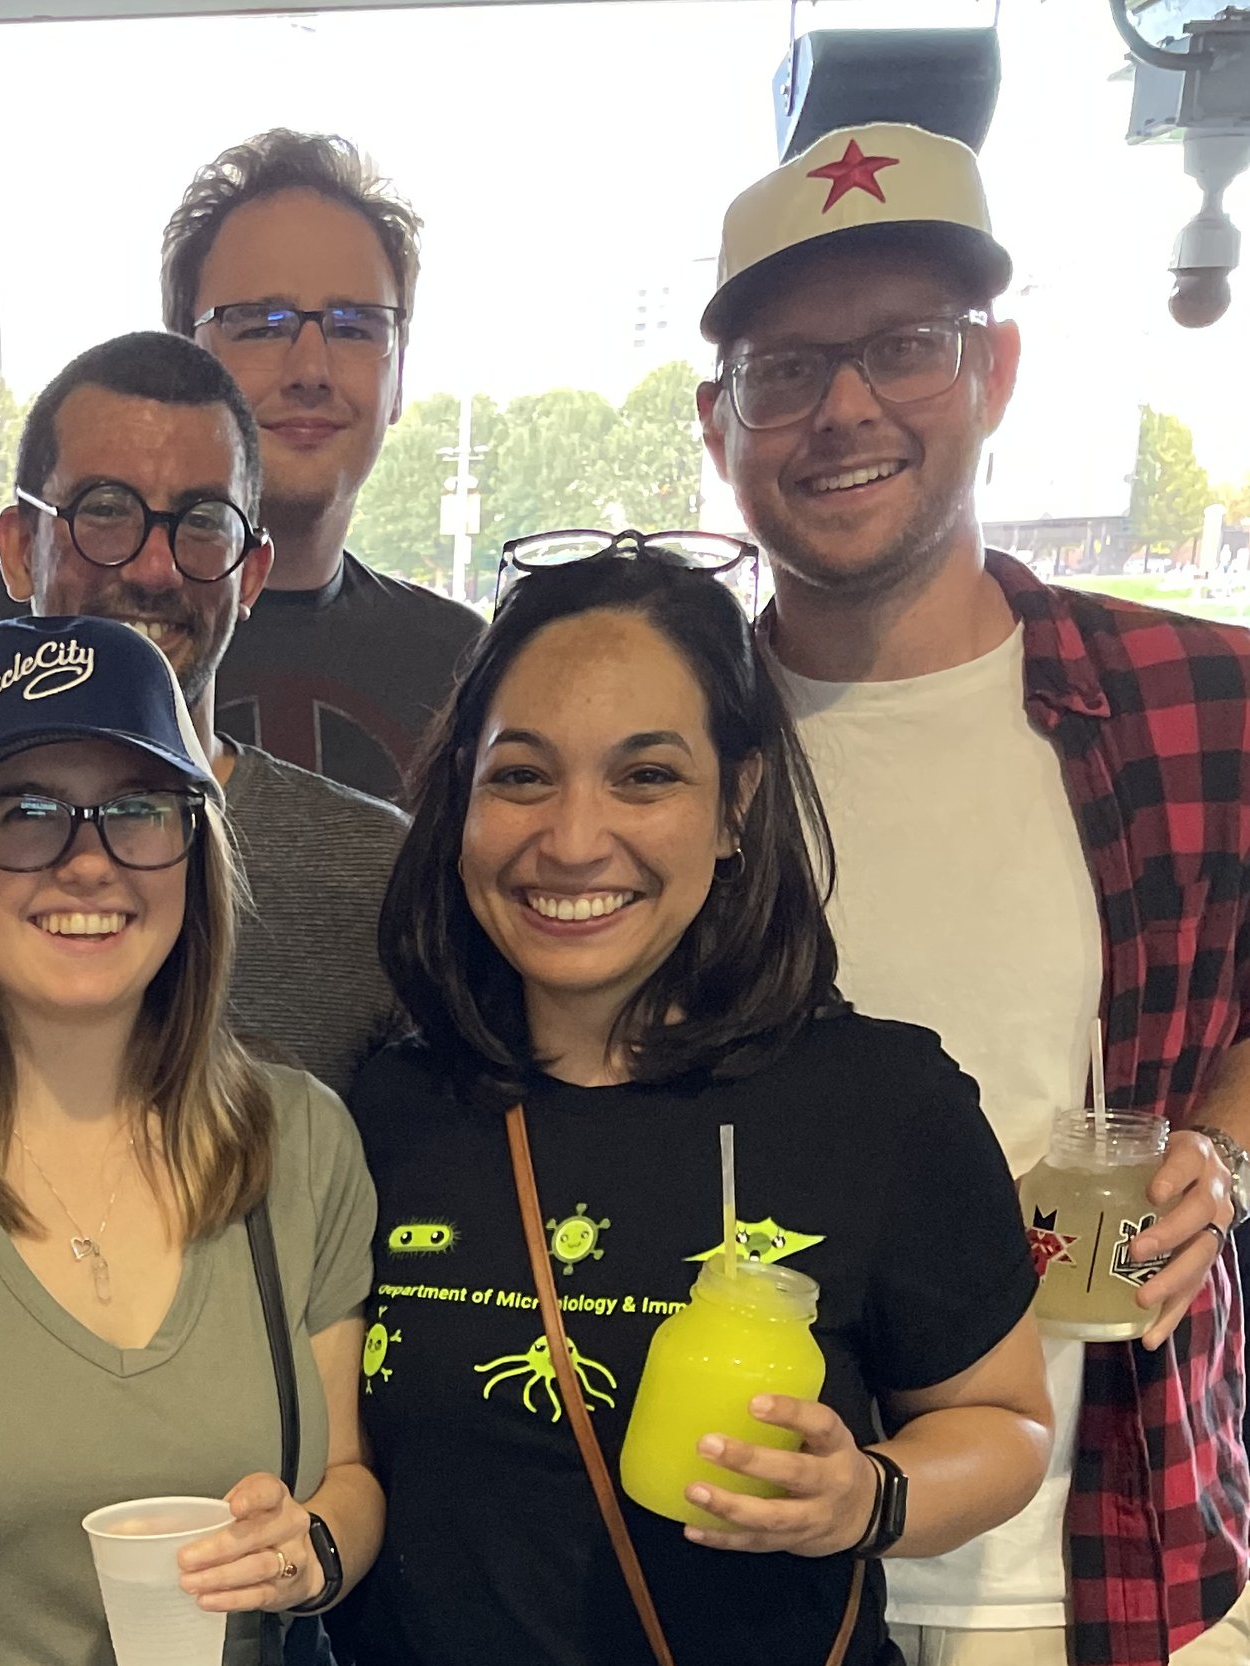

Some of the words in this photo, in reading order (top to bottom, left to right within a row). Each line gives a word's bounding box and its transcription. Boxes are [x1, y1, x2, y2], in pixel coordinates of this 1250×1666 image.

[378, 1284, 467, 1302] Department
[471, 1288, 493, 1305] of
[496, 1290, 618, 1316] Micriology
[622, 1295, 637, 1313] &
